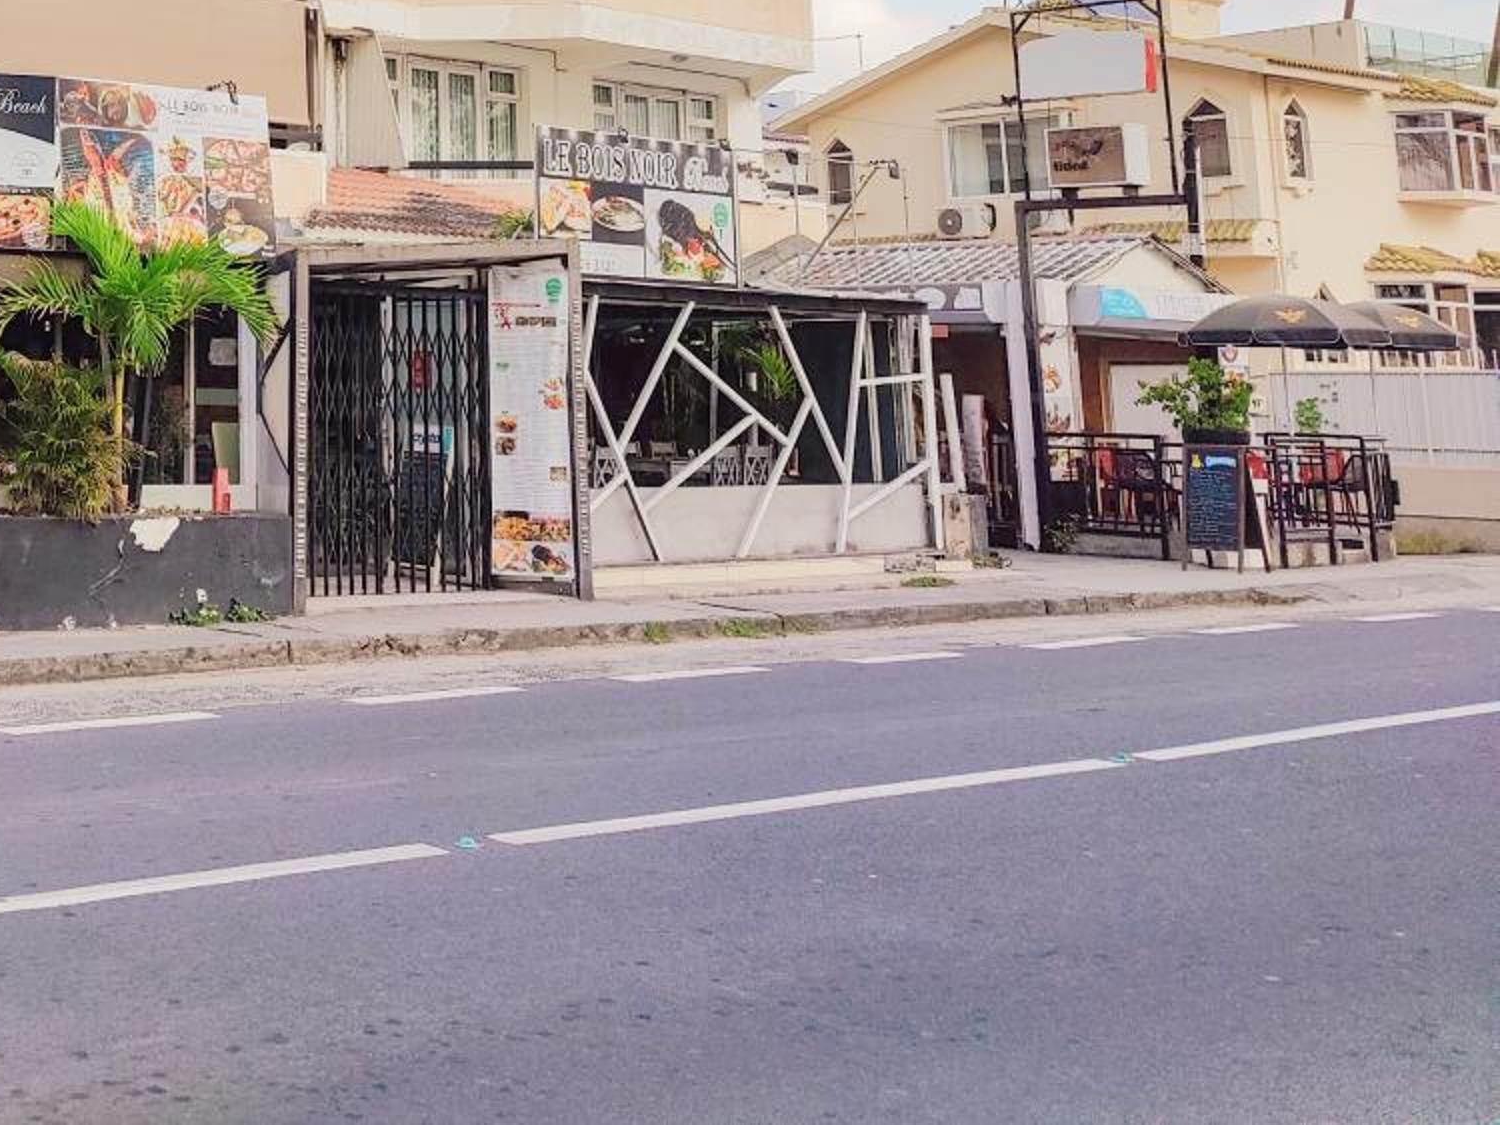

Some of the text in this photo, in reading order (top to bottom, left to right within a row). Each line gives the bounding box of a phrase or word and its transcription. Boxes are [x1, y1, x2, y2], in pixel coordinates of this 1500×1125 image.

[543, 138, 572, 176] LE
[575, 142, 626, 183] BOIS
[629, 148, 678, 189] NOIR
